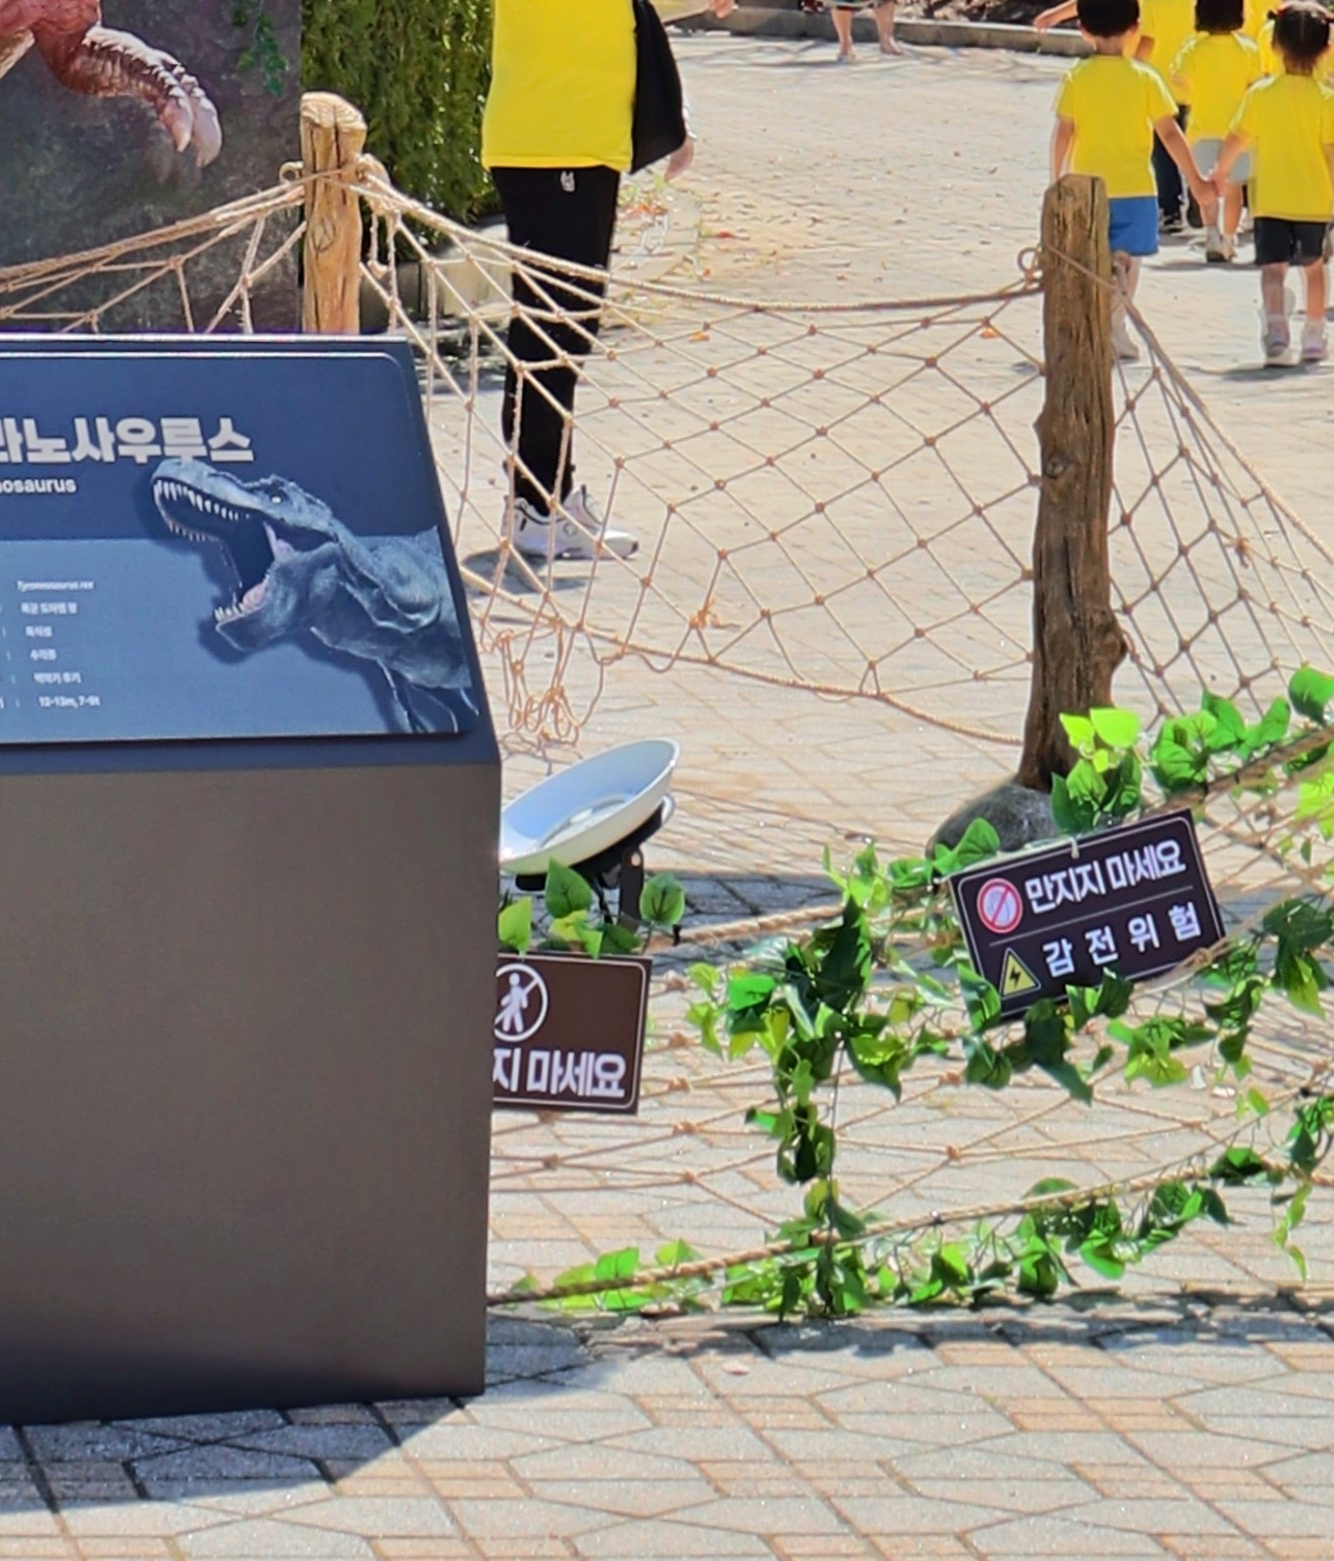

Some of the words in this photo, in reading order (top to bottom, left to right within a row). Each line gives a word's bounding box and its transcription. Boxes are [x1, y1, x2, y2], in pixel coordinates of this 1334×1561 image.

[1025, 861, 1106, 914] 만지지
[1106, 840, 1186, 891] 마세요
[526, 1050, 627, 1098] 마세요
